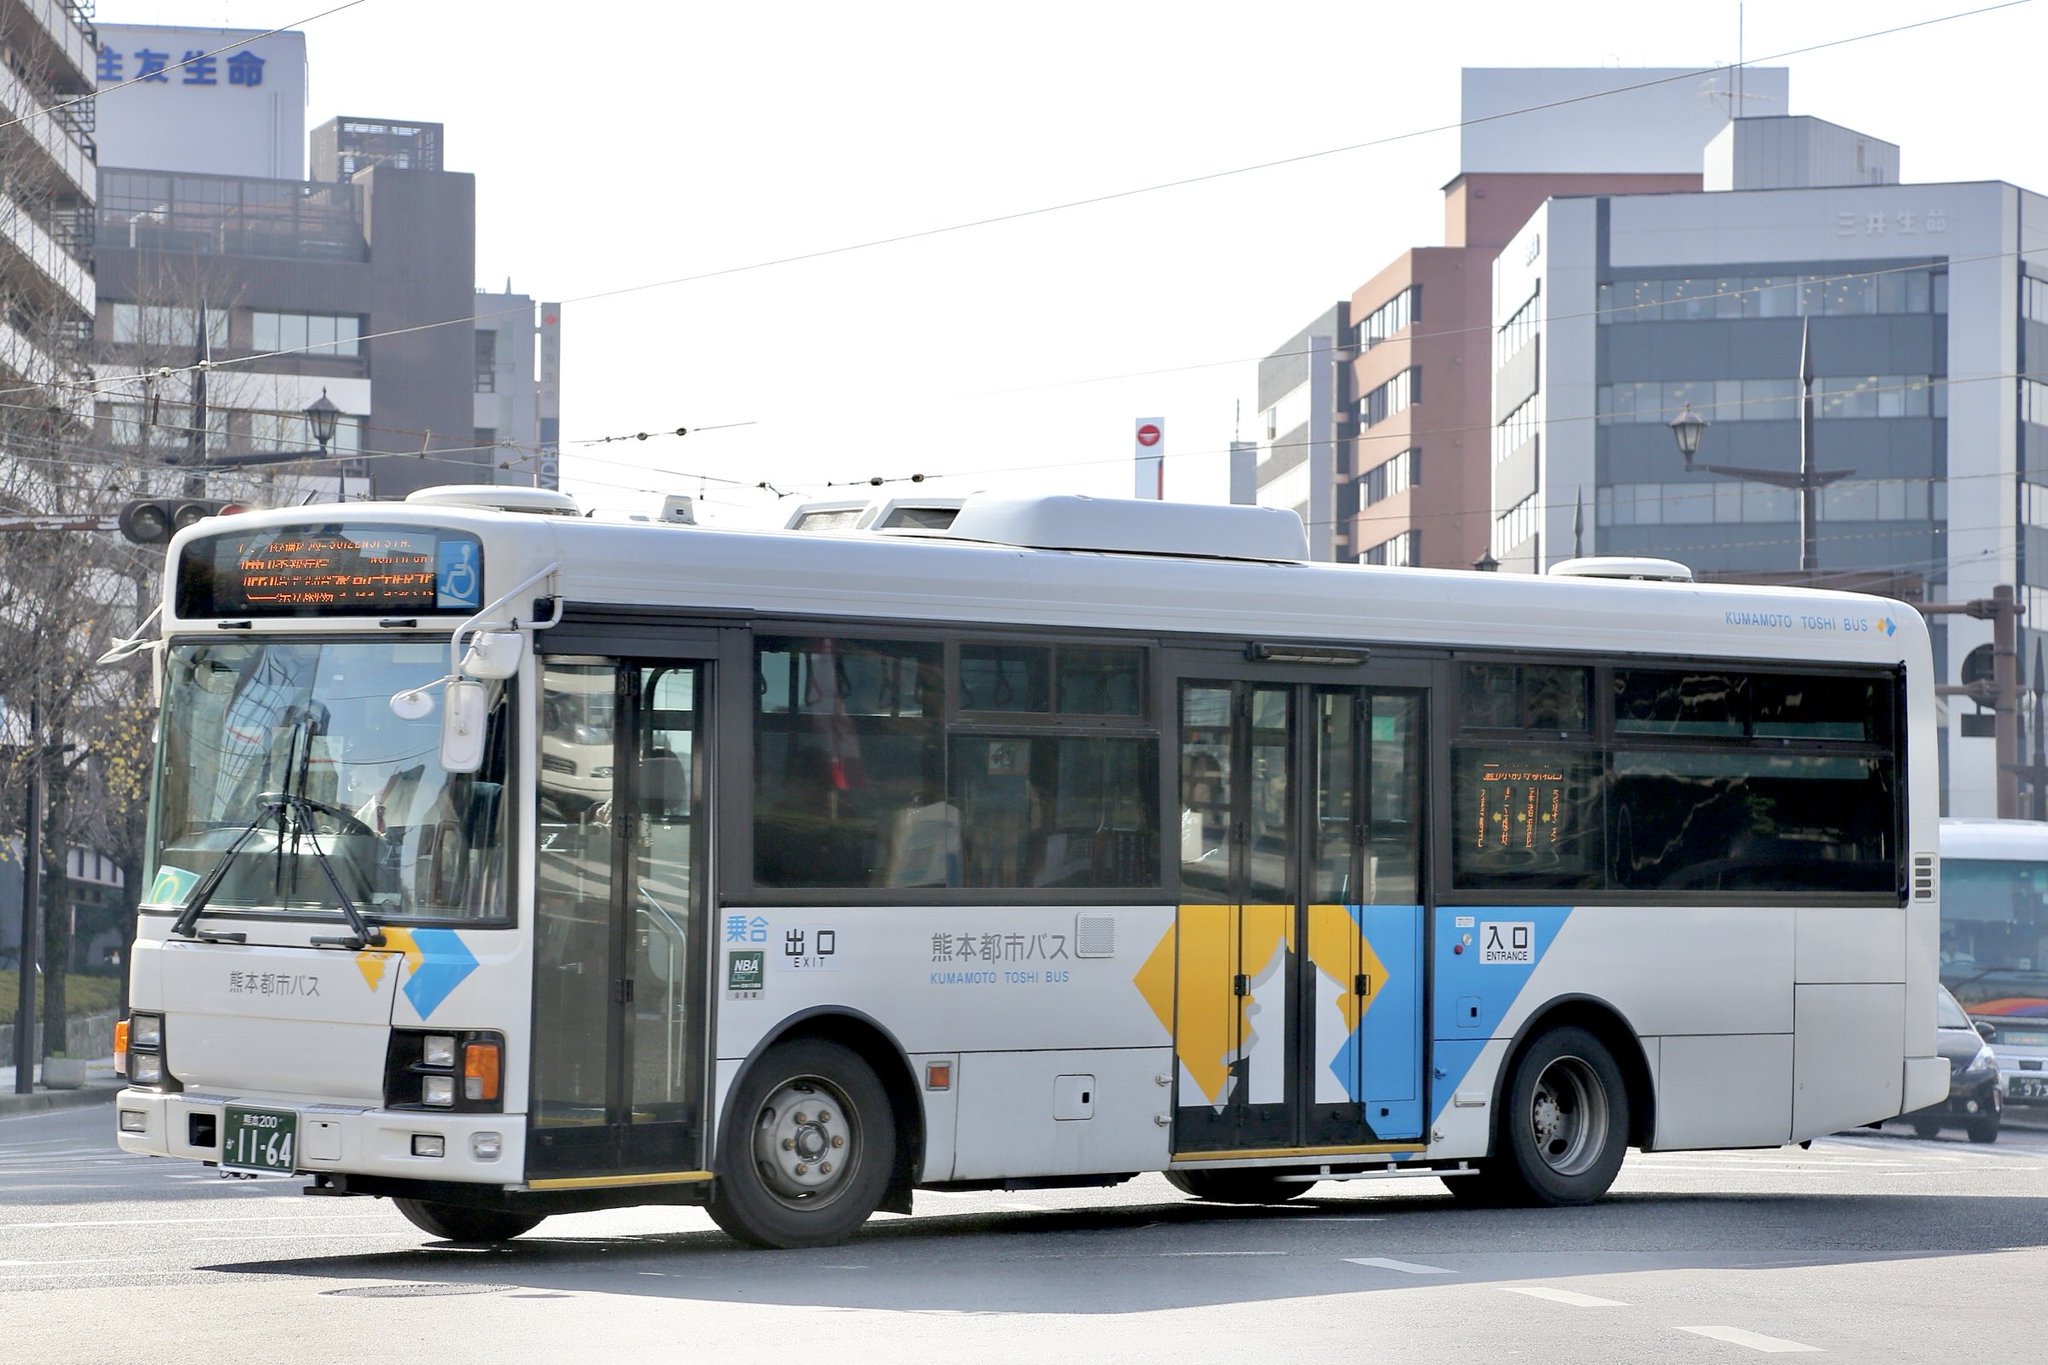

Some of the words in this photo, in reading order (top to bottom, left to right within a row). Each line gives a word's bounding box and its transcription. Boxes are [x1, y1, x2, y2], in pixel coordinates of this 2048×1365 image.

[1837, 208, 1946, 237] 三井生命
[1725, 611, 1792, 628] KUMAMOTO
[1801, 615, 1836, 630] TOSHI
[1844, 618, 1868, 632] BUS
[727, 915, 769, 942] 乗合
[1486, 926, 1528, 950] 入口
[785, 928, 835, 956] 出口
[931, 932, 1070, 964] 熊本都市バス
[734, 959, 759, 972] NBA
[794, 957, 825, 968] EXIT
[1486, 951, 1528, 961] ENTRANCE
[229, 970, 320, 997] 熊本都市バス
[930, 971, 997, 985] KUMAMOTO
[1004, 971, 1039, 984] TOSHI
[1045, 970, 1070, 983] BUS
[238, 1128, 292, 1167] 11-64
